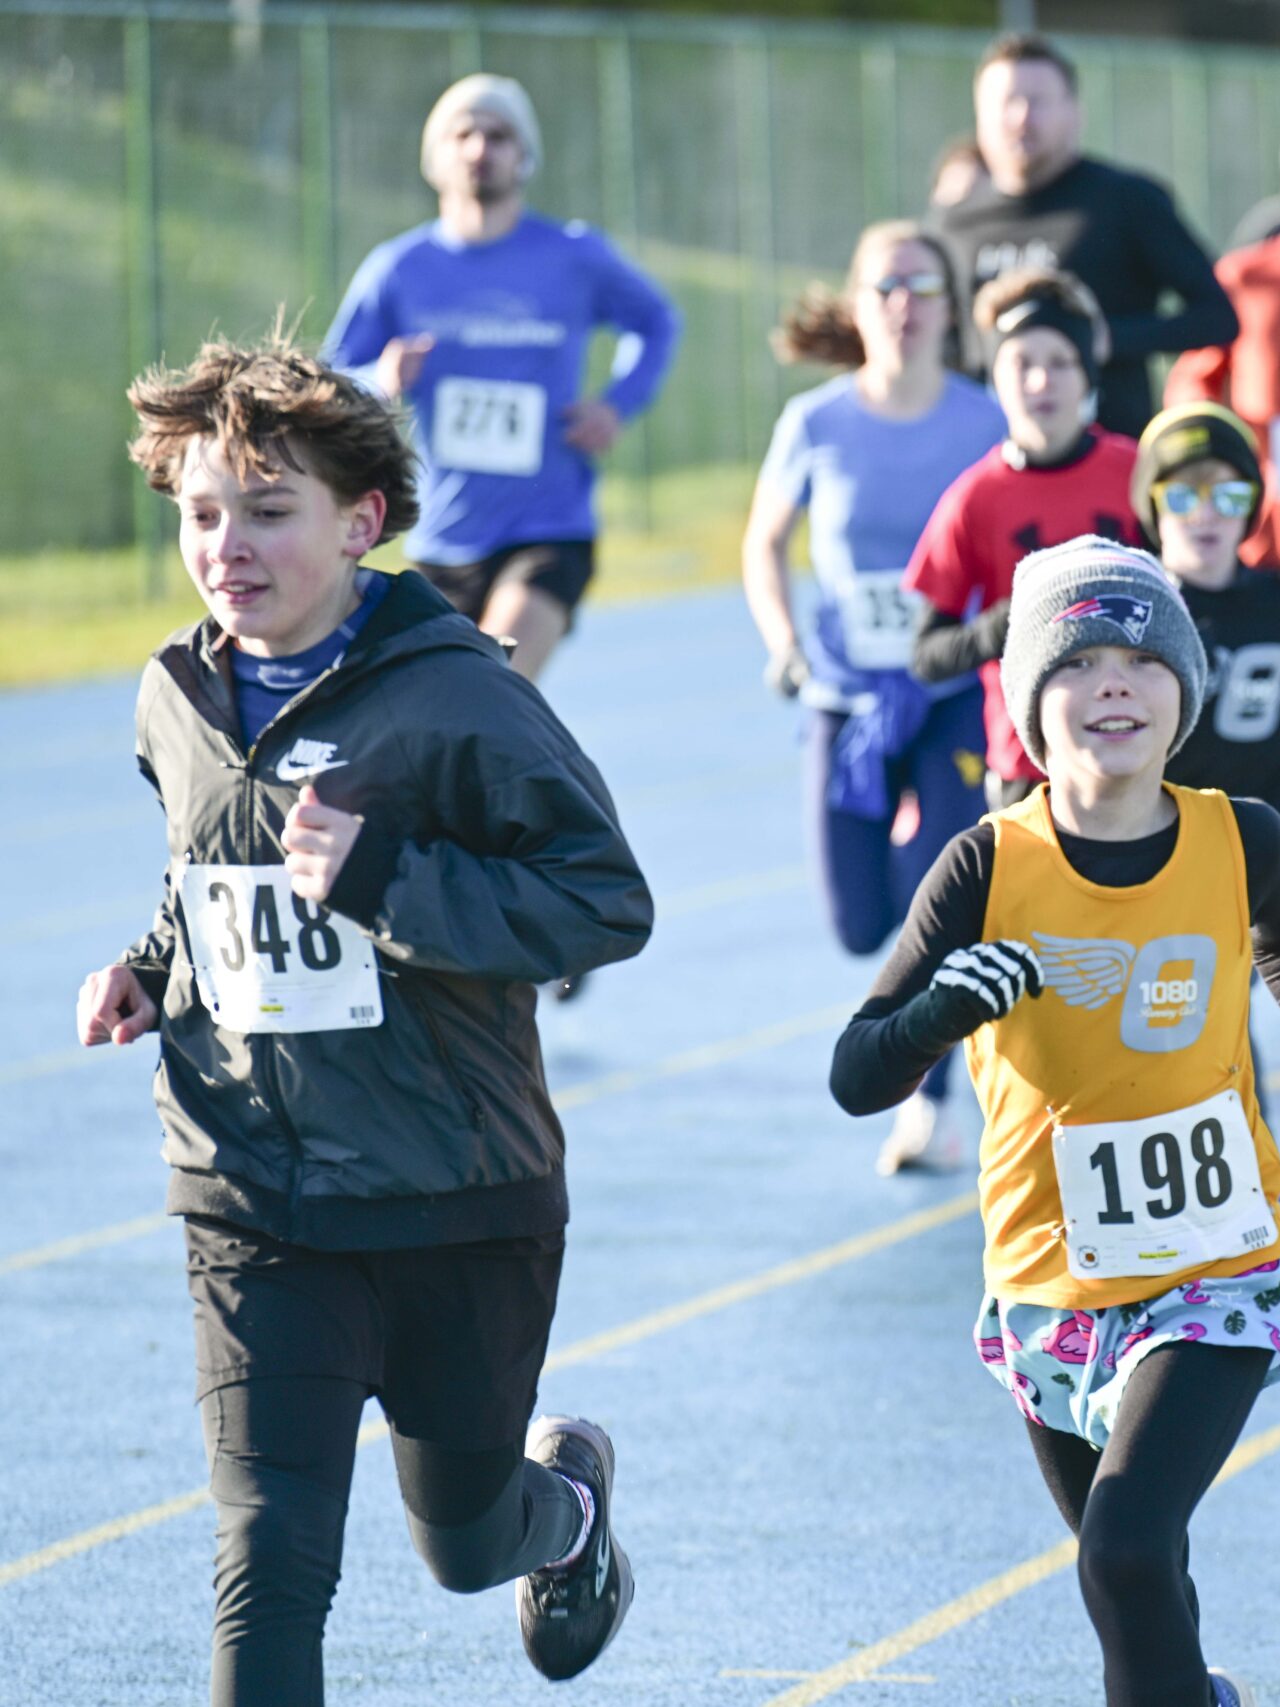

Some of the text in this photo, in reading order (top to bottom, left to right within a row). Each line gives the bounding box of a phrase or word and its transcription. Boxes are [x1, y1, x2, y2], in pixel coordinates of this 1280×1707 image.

[290, 738, 338, 766] NIKE
[209, 881, 342, 974] 348
[1138, 979, 1199, 1006] 1080
[1089, 1117, 1233, 1225] 198
